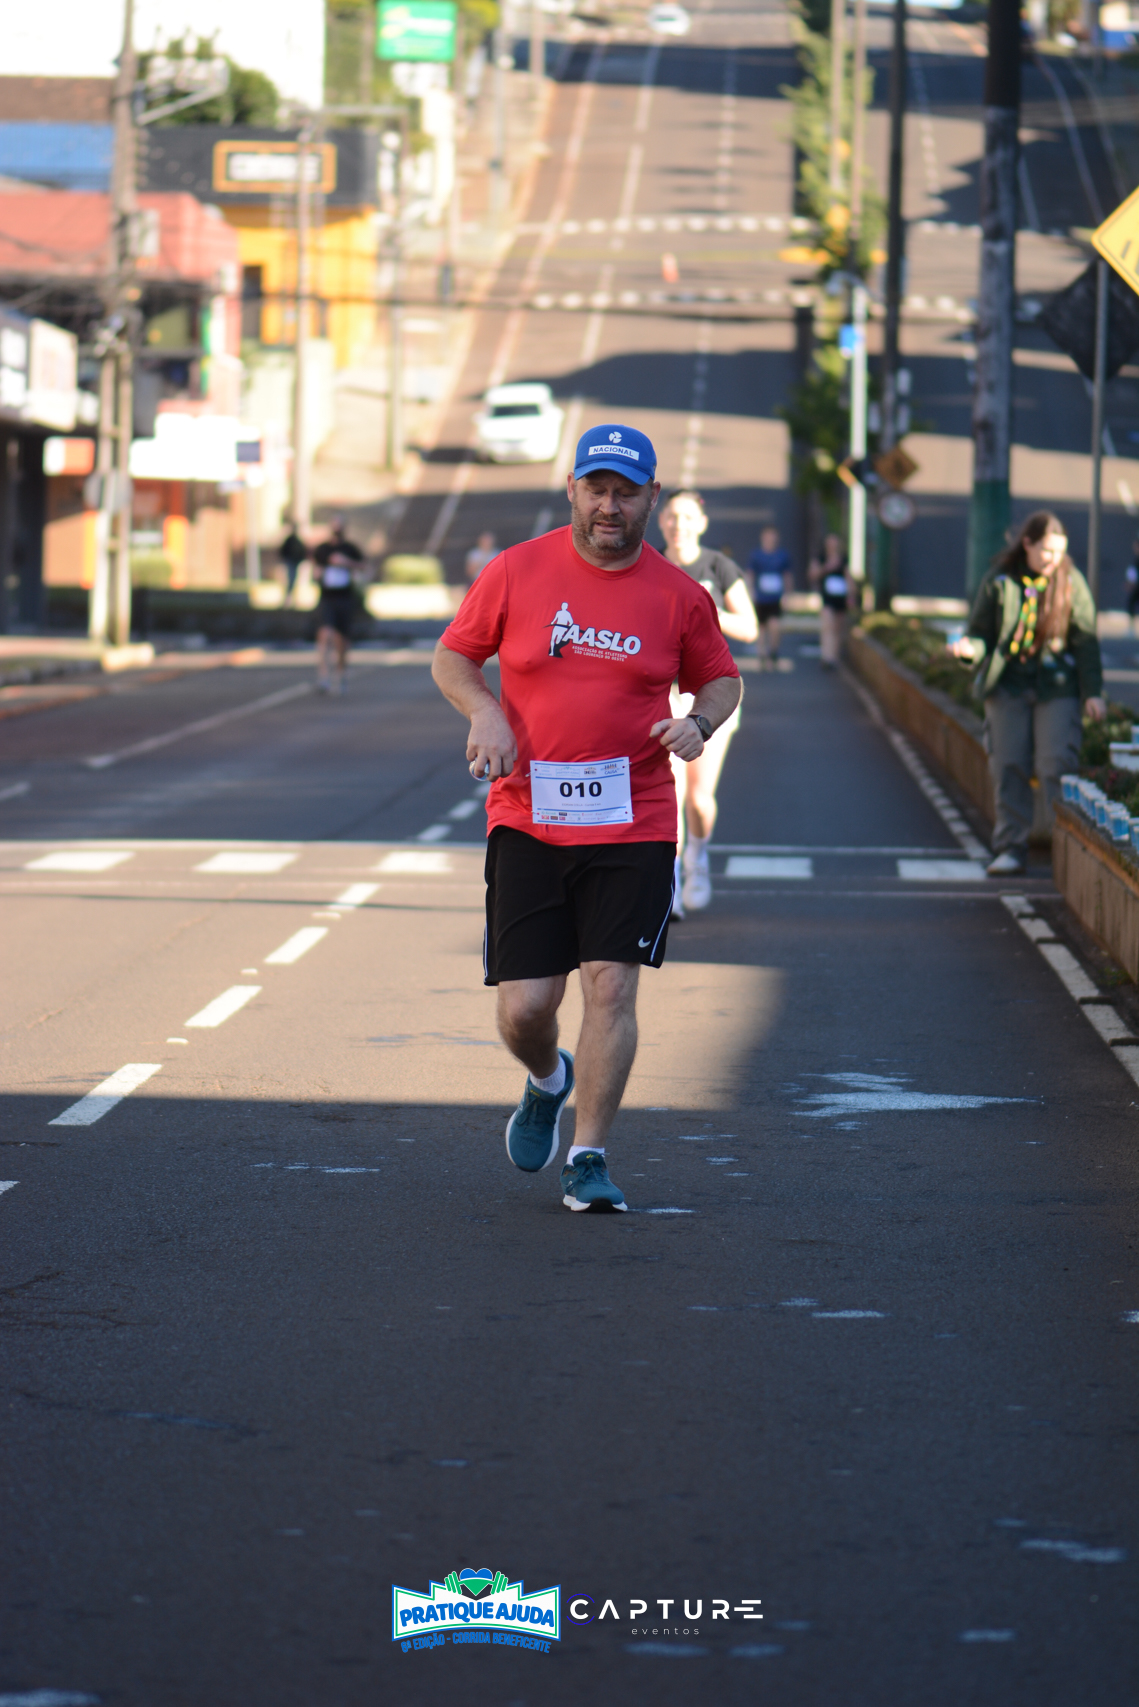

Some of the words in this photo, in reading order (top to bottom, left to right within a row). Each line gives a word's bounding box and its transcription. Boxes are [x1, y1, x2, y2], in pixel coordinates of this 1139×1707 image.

[593, 446, 634, 457] NACIONAL
[562, 624, 642, 655] AASLO
[571, 645, 598, 654] ASSOCIAÇÃO
[604, 651, 628, 659] ATLETISMO
[583, 651, 604, 659] LOURENÇO
[559, 781, 603, 798] 010
